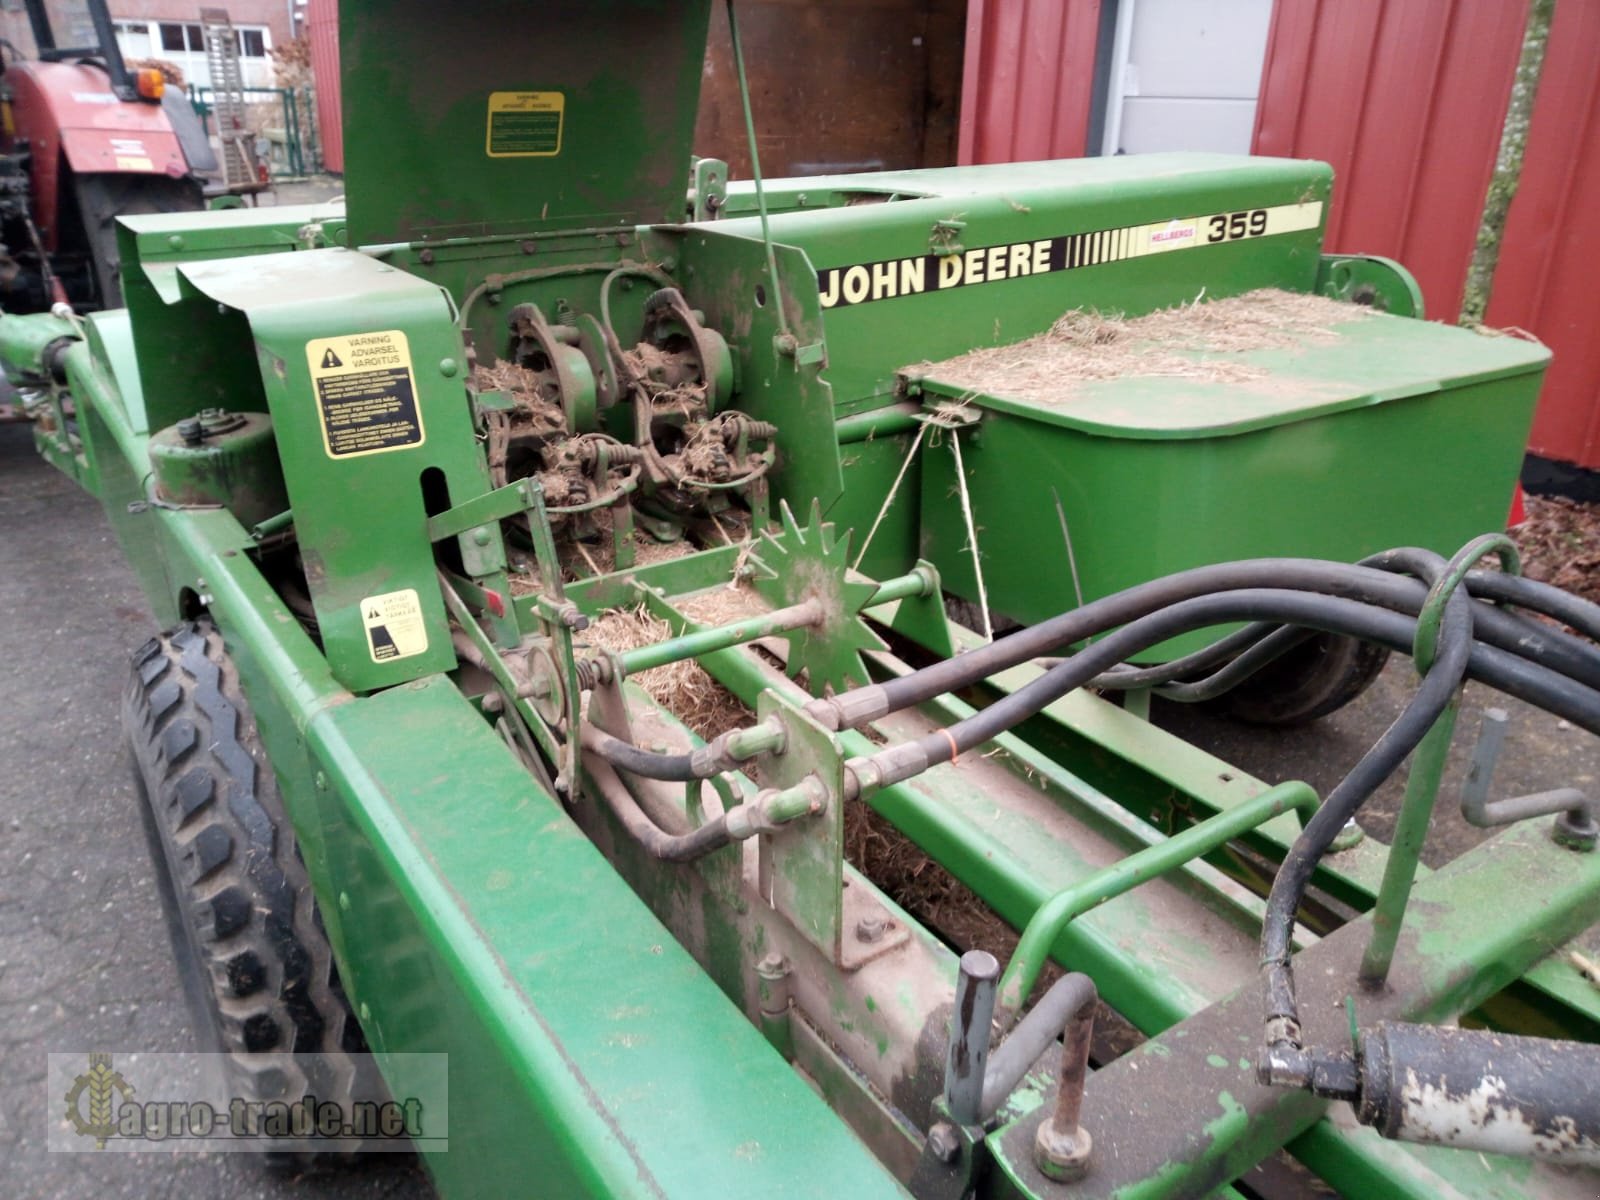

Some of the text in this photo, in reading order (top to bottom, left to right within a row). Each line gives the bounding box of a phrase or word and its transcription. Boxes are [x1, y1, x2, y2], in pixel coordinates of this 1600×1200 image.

[1208, 209, 1267, 243] 359
[819, 240, 1053, 308] JOHN DEERE
[348, 336, 391, 347] VARNING
[352, 346, 398, 357] ADVARSEL
[353, 356, 400, 368] VAROITUS
